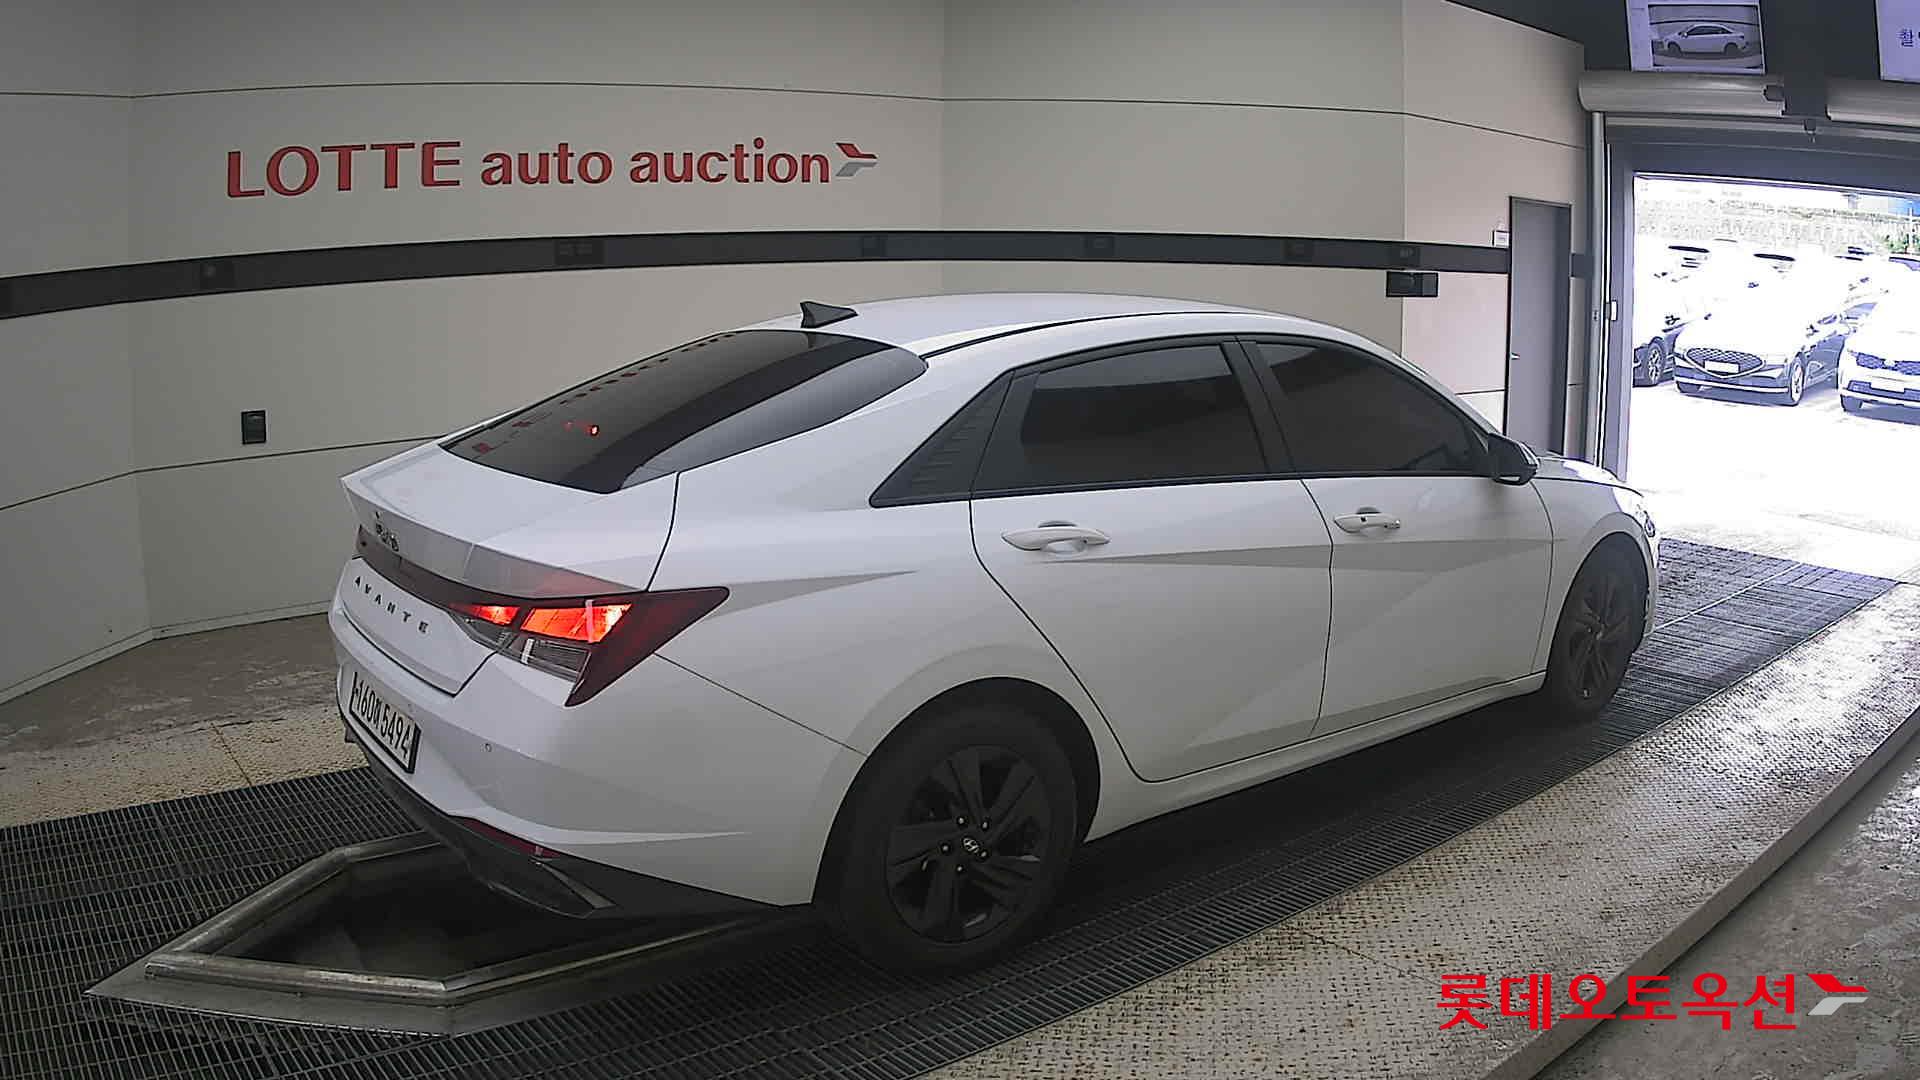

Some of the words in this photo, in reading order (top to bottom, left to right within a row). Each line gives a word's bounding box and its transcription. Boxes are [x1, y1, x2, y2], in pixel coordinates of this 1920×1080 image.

[227, 141, 461, 198] LOTTE
[480, 142, 613, 186] auto
[629, 137, 831, 184] auction
[355, 576, 429, 633] AVANTE
